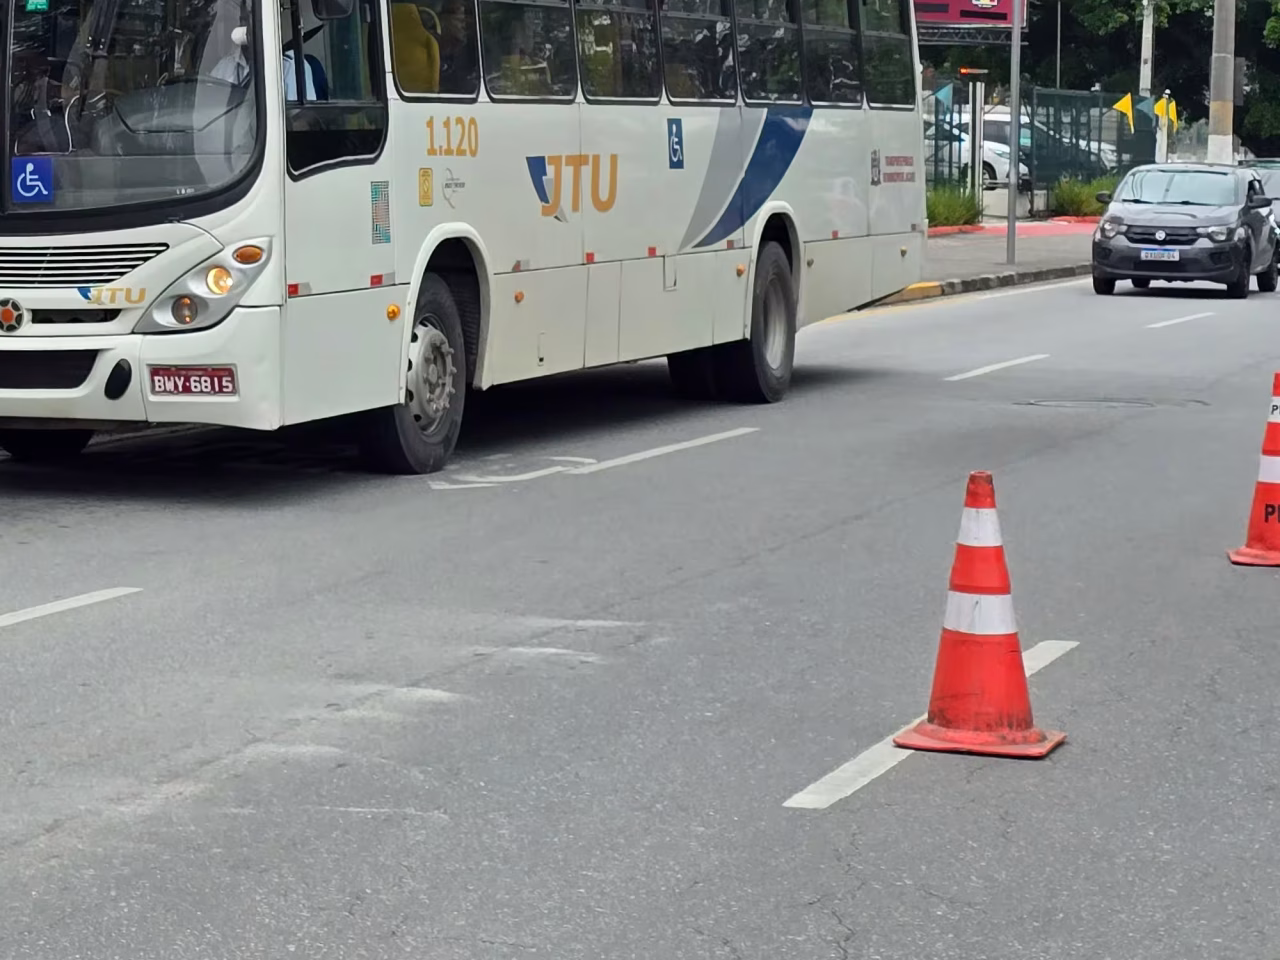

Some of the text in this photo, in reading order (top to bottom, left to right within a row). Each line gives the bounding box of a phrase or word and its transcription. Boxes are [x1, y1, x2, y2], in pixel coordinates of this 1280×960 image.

[426, 116, 479, 158] 1.120
[541, 153, 618, 217] JTU
[87, 287, 147, 305] JTU
